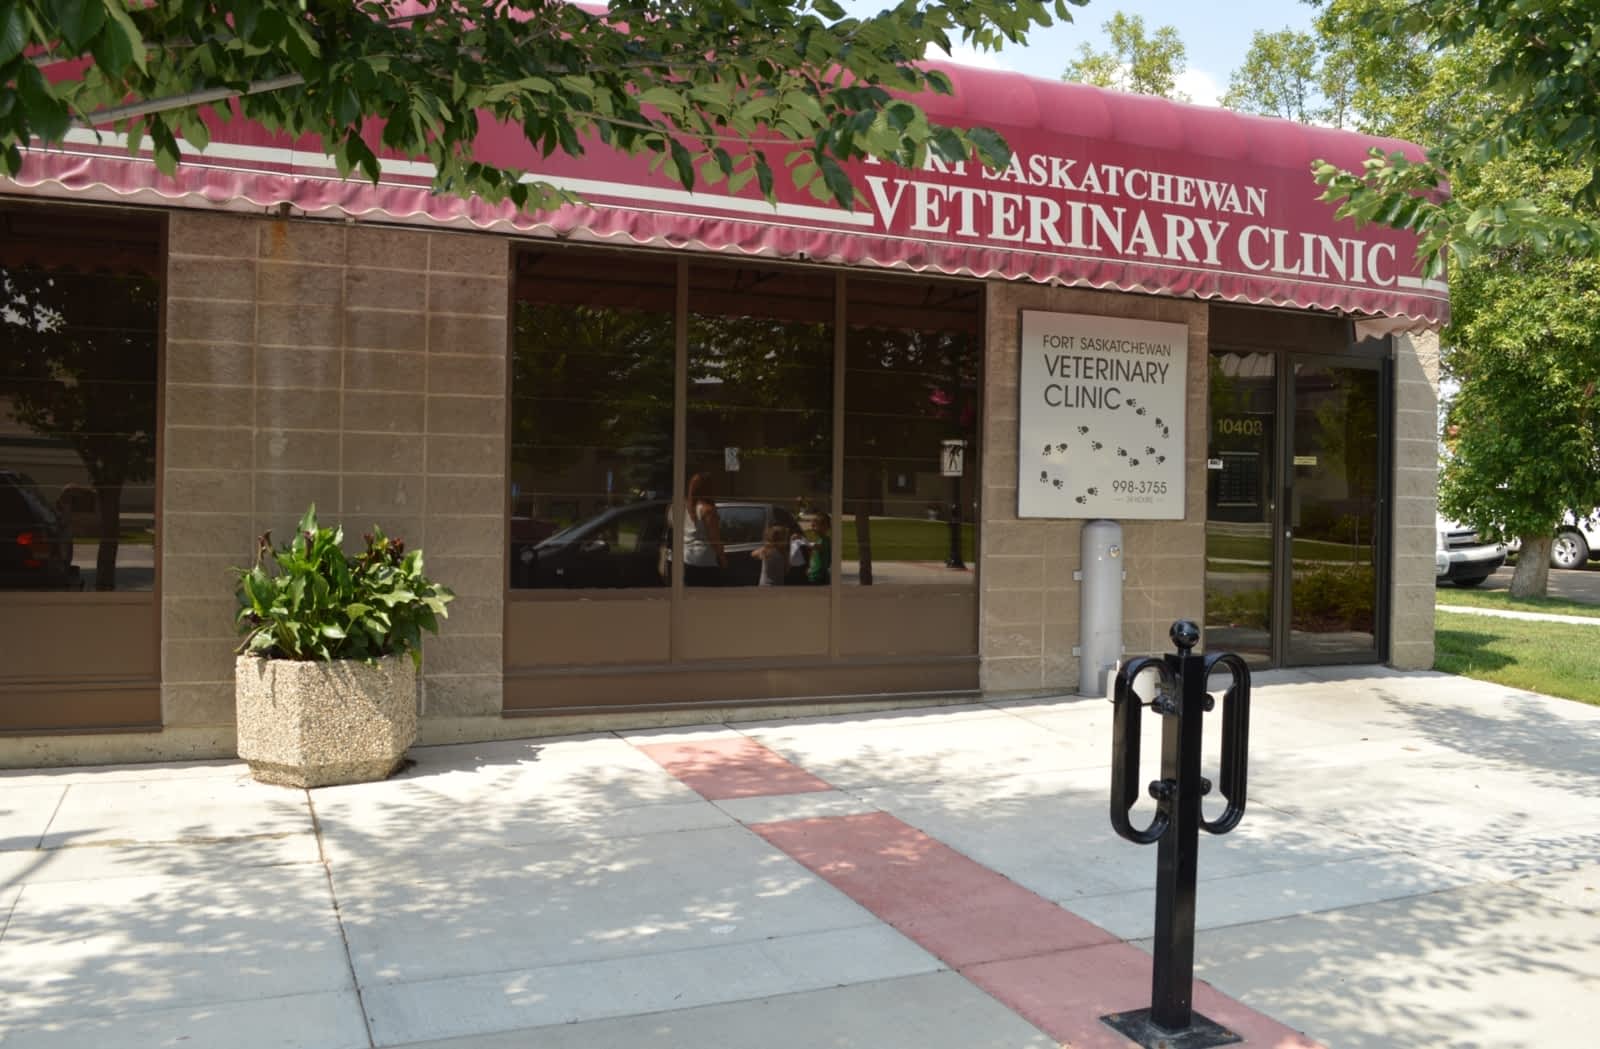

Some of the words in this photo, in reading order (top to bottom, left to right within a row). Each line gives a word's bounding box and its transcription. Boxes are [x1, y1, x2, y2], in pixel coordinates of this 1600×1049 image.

[865, 175, 1227, 265] VETERINARY
[1238, 225, 1396, 286] CLINIC
[1043, 335, 1075, 349] FORT
[1080, 337, 1171, 356] SASKATCHEWAN
[1044, 354, 1169, 384] VETERINARY
[1044, 384, 1121, 410] CLINIC
[1112, 480, 1168, 494] 998-3755
